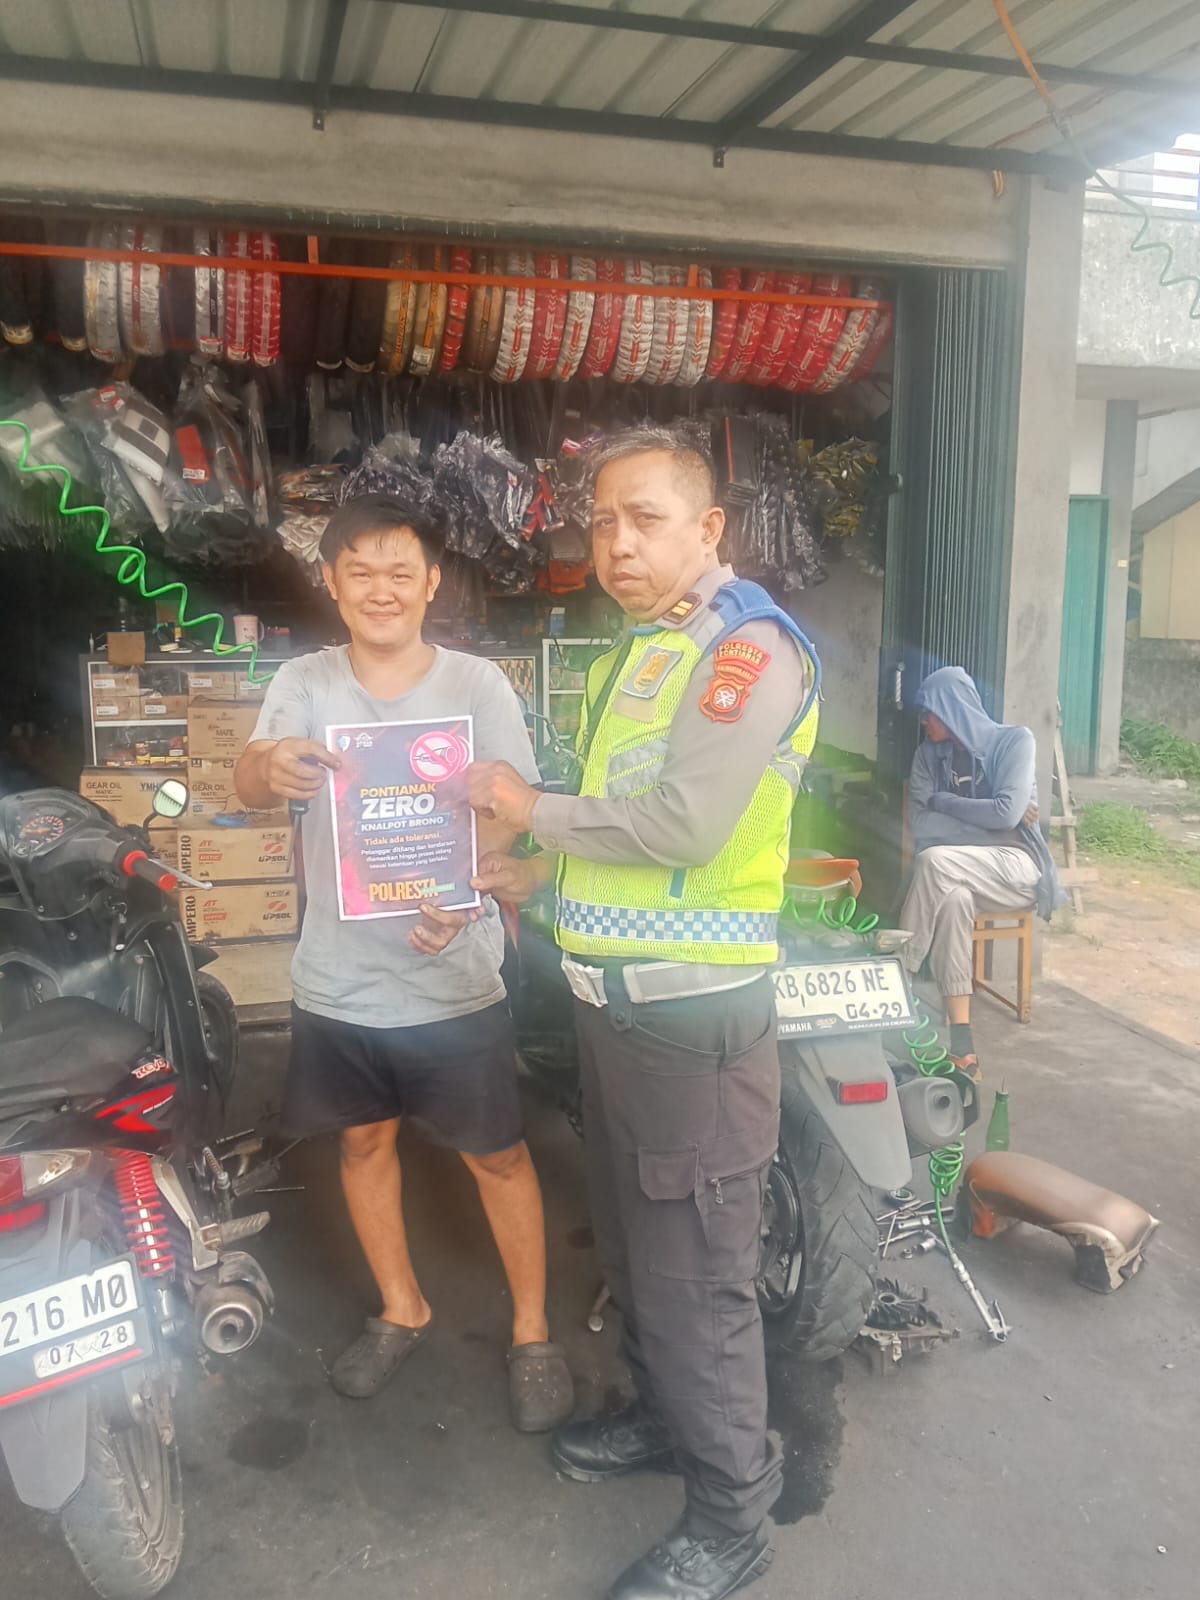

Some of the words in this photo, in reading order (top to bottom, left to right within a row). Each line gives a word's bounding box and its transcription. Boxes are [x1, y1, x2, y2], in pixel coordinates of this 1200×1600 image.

[110, 781, 122, 789] OIL
[192, 783, 213, 791] GEAR
[215, 783, 226, 791] OIL
[360, 783, 436, 798] PONTIANAK
[361, 793, 435, 819] ZERO
[361, 820, 407, 832] KNALPOT
[409, 816, 444, 827] BRONG
[364, 837, 388, 846] Tidak
[390, 835, 405, 843] ada
[406, 831, 443, 842] toleransi.
[368, 877, 439, 902] POLRESTA
[774, 974, 799, 999] KB
[804, 970, 857, 997] 6826
[861, 967, 889, 992] NE
[780, 1021, 812, 1033] YAMAHA
[1, 1296, 65, 1348] 216
